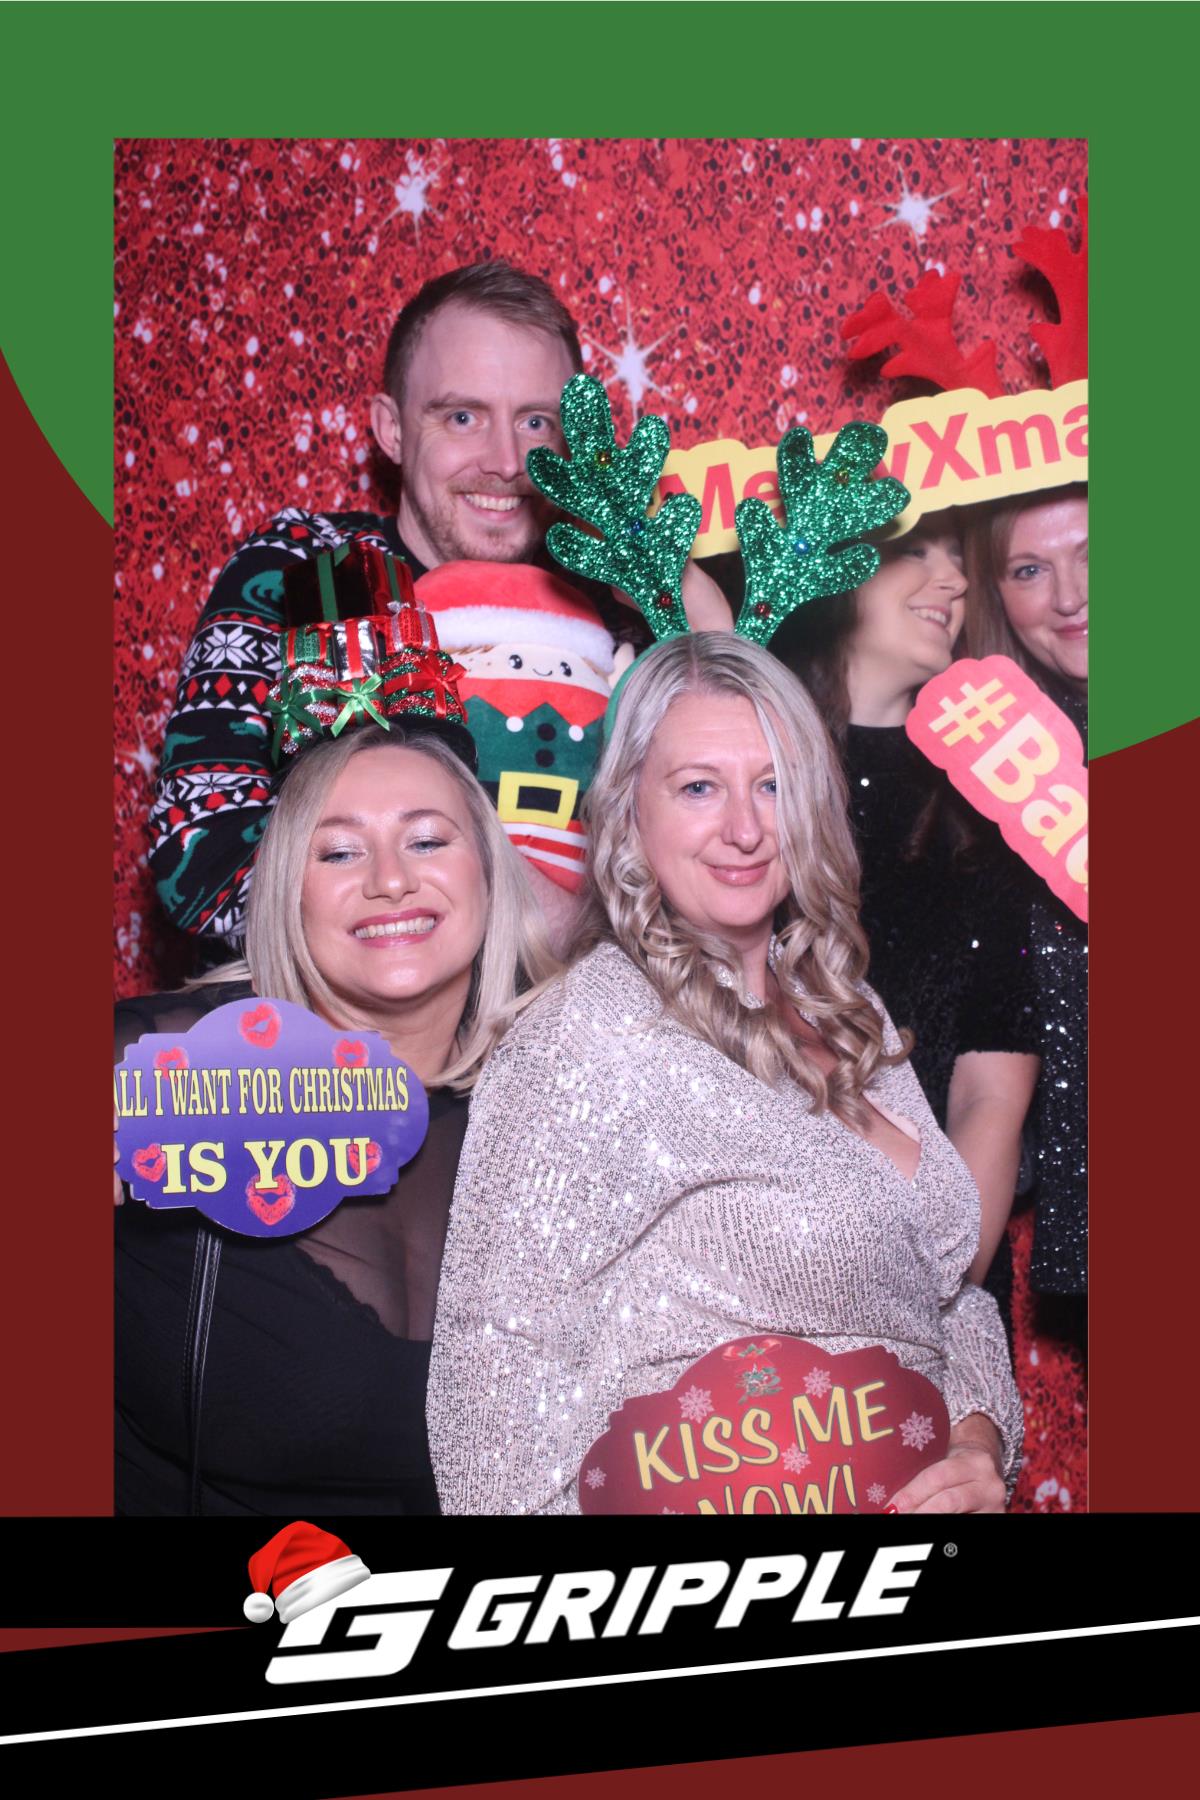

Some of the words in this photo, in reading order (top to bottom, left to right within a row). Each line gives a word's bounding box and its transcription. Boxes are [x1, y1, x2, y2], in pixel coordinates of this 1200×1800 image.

[114, 1069, 148, 1117] LL
[154, 1069, 164, 1116] I
[169, 1068, 232, 1115] WANT
[238, 1067, 284, 1114] FOR
[289, 1066, 409, 1114] CHRISTMAS
[161, 1141, 228, 1194] IS
[244, 1137, 371, 1190] YOU
[634, 1408, 779, 1490] KISS
[793, 1380, 894, 1453] ME
